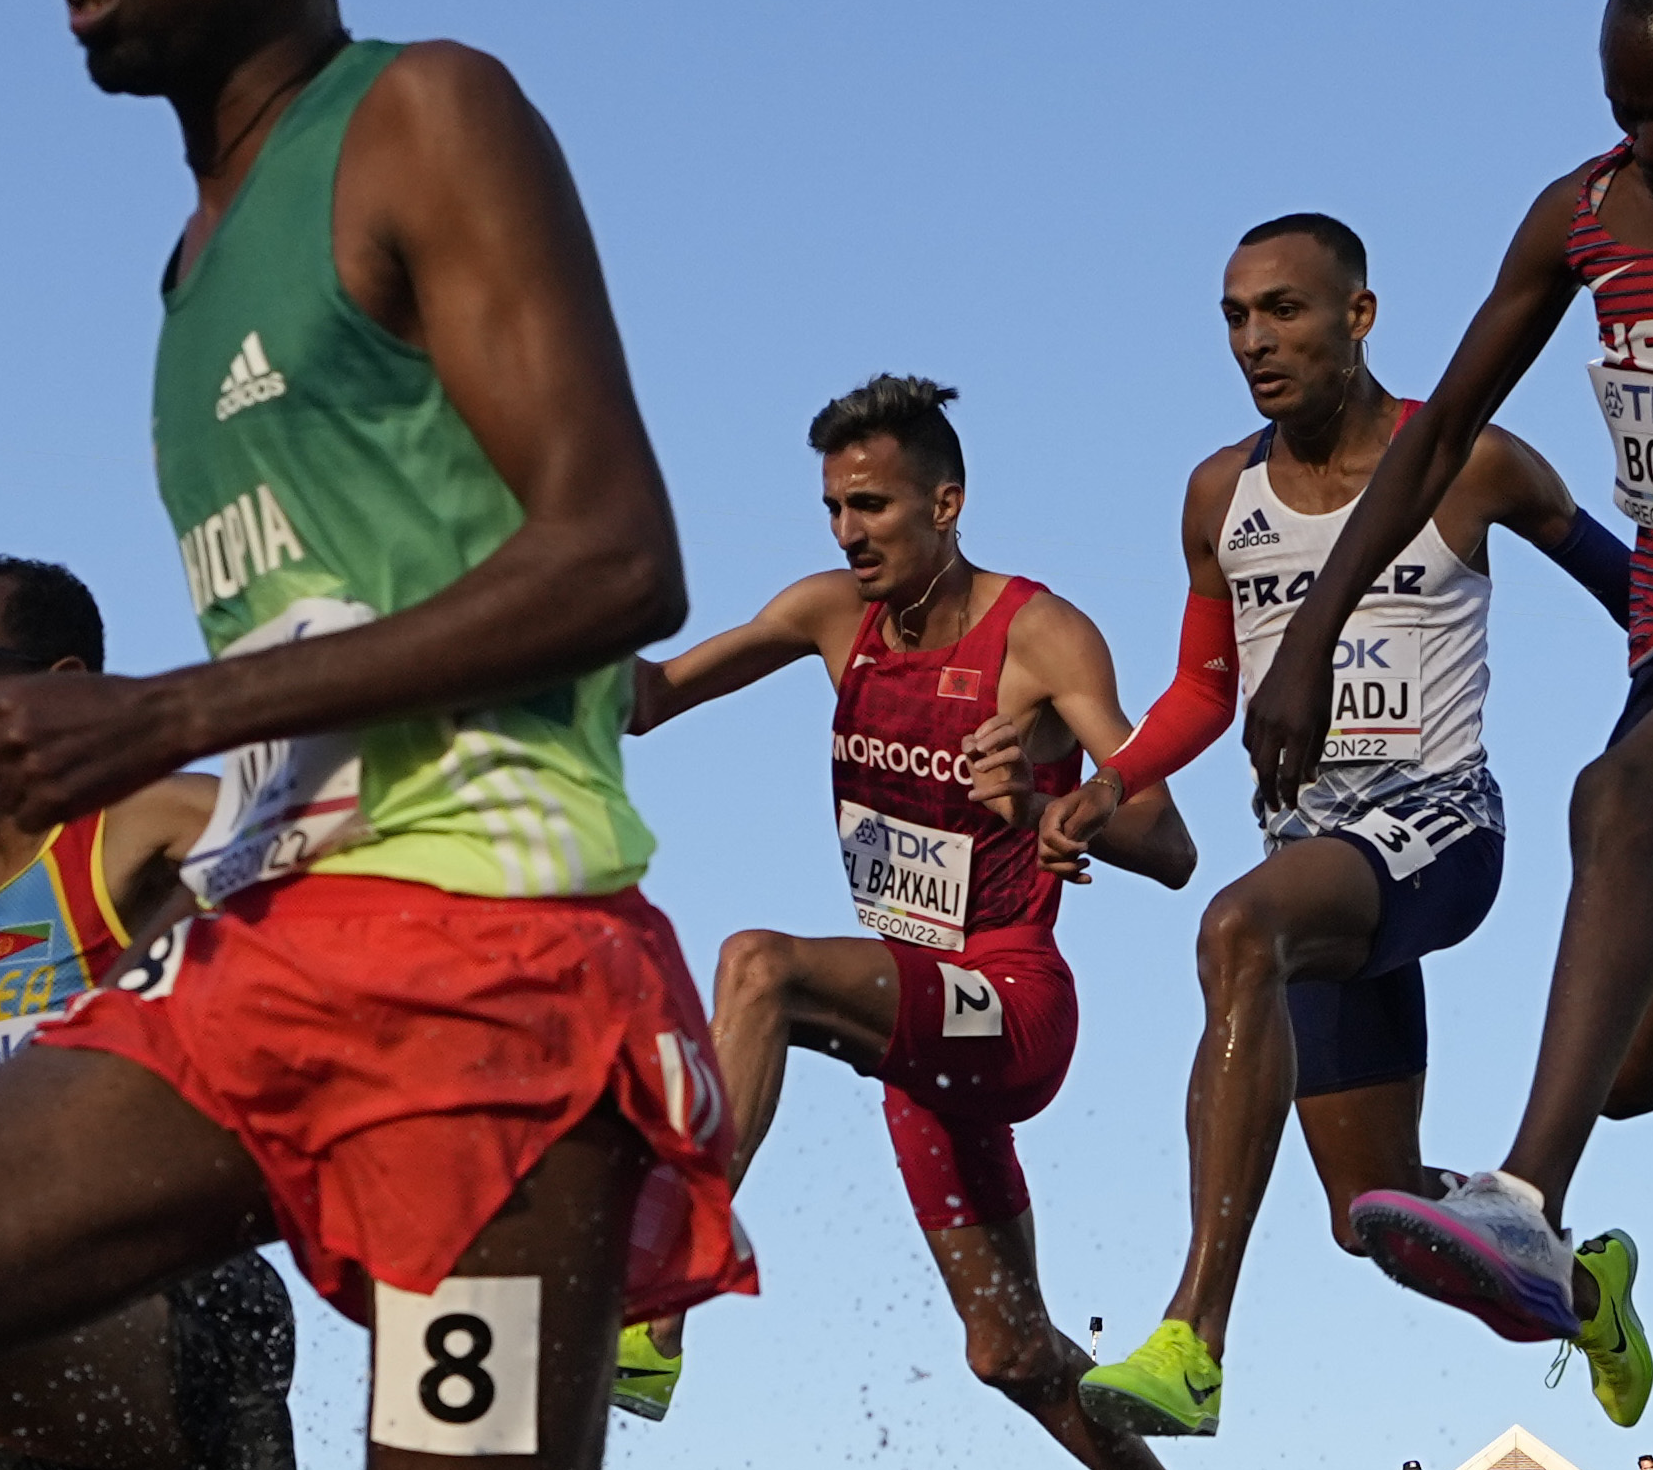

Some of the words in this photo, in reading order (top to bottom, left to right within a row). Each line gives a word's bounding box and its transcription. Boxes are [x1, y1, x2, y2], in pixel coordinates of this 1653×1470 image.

[1228, 529, 1280, 552] adidas
[1236, 564, 1427, 610] FRAE
[1332, 638, 1391, 670] DK
[833, 732, 974, 785] MOROCCO
[1323, 738, 1388, 758] ON22
[876, 822, 948, 868] TDK
[1376, 823, 1413, 853] 3
[866, 858, 961, 917] BAKKALI
[857, 907, 938, 946] REGON22
[955, 984, 992, 1016] 2
[417, 1312, 495, 1424] 8
